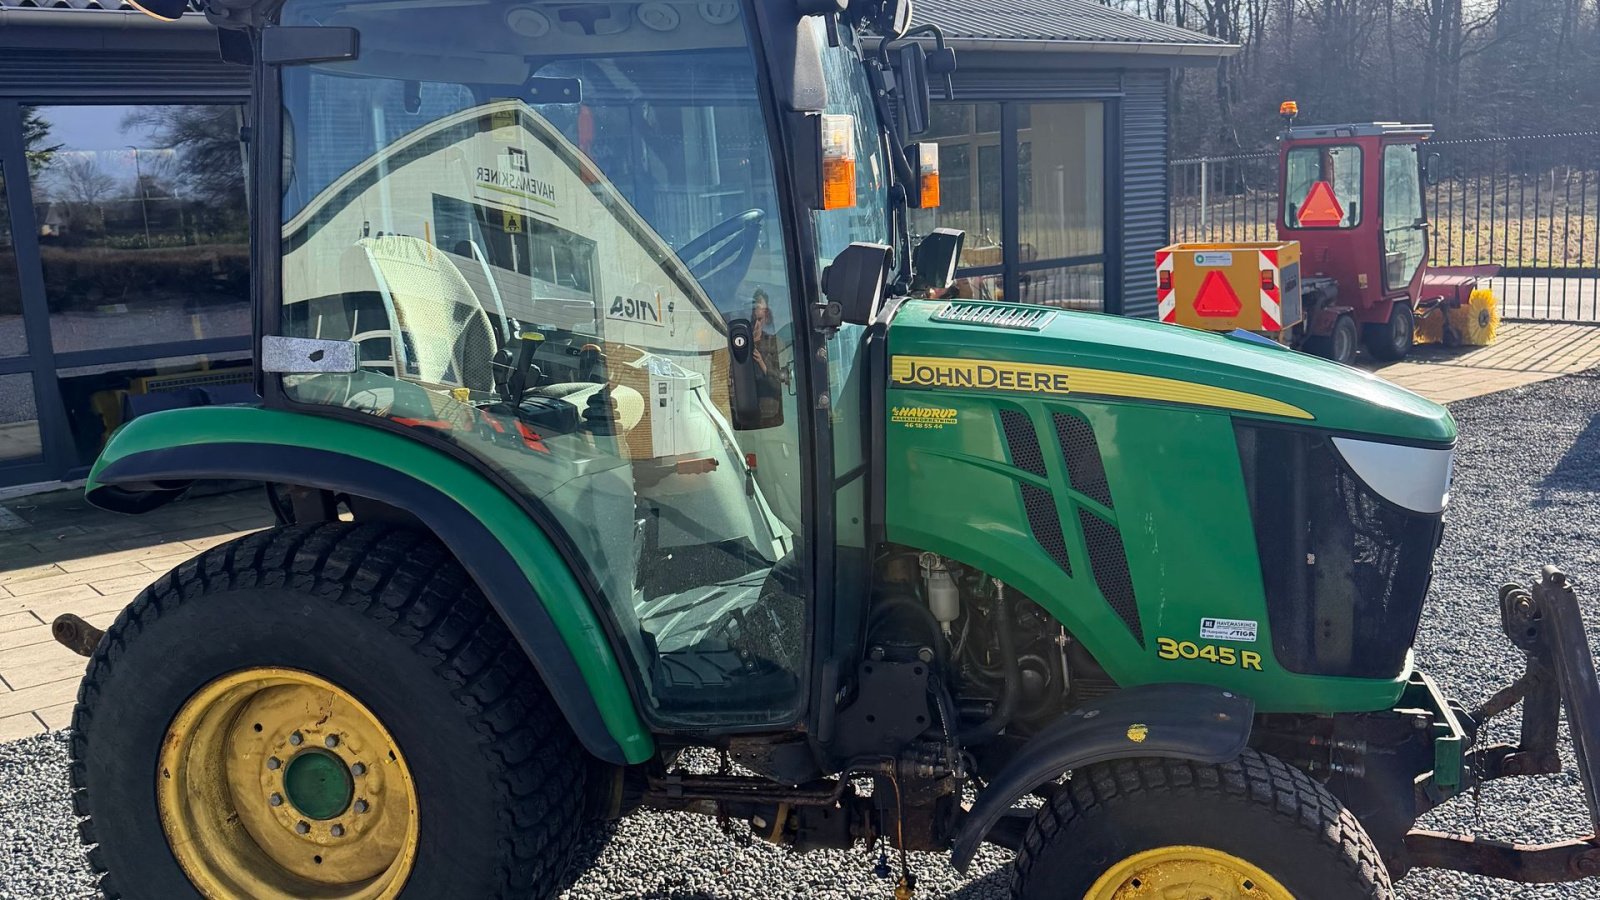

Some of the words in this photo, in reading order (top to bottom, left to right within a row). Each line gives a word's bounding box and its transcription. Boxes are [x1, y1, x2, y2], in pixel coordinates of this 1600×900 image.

[901, 361, 973, 386] JOHN
[977, 365, 1070, 391] DEERE
[899, 407, 958, 418] HAVDRUP
[1157, 637, 1237, 665] 3045
[1241, 650, 1263, 671] R
